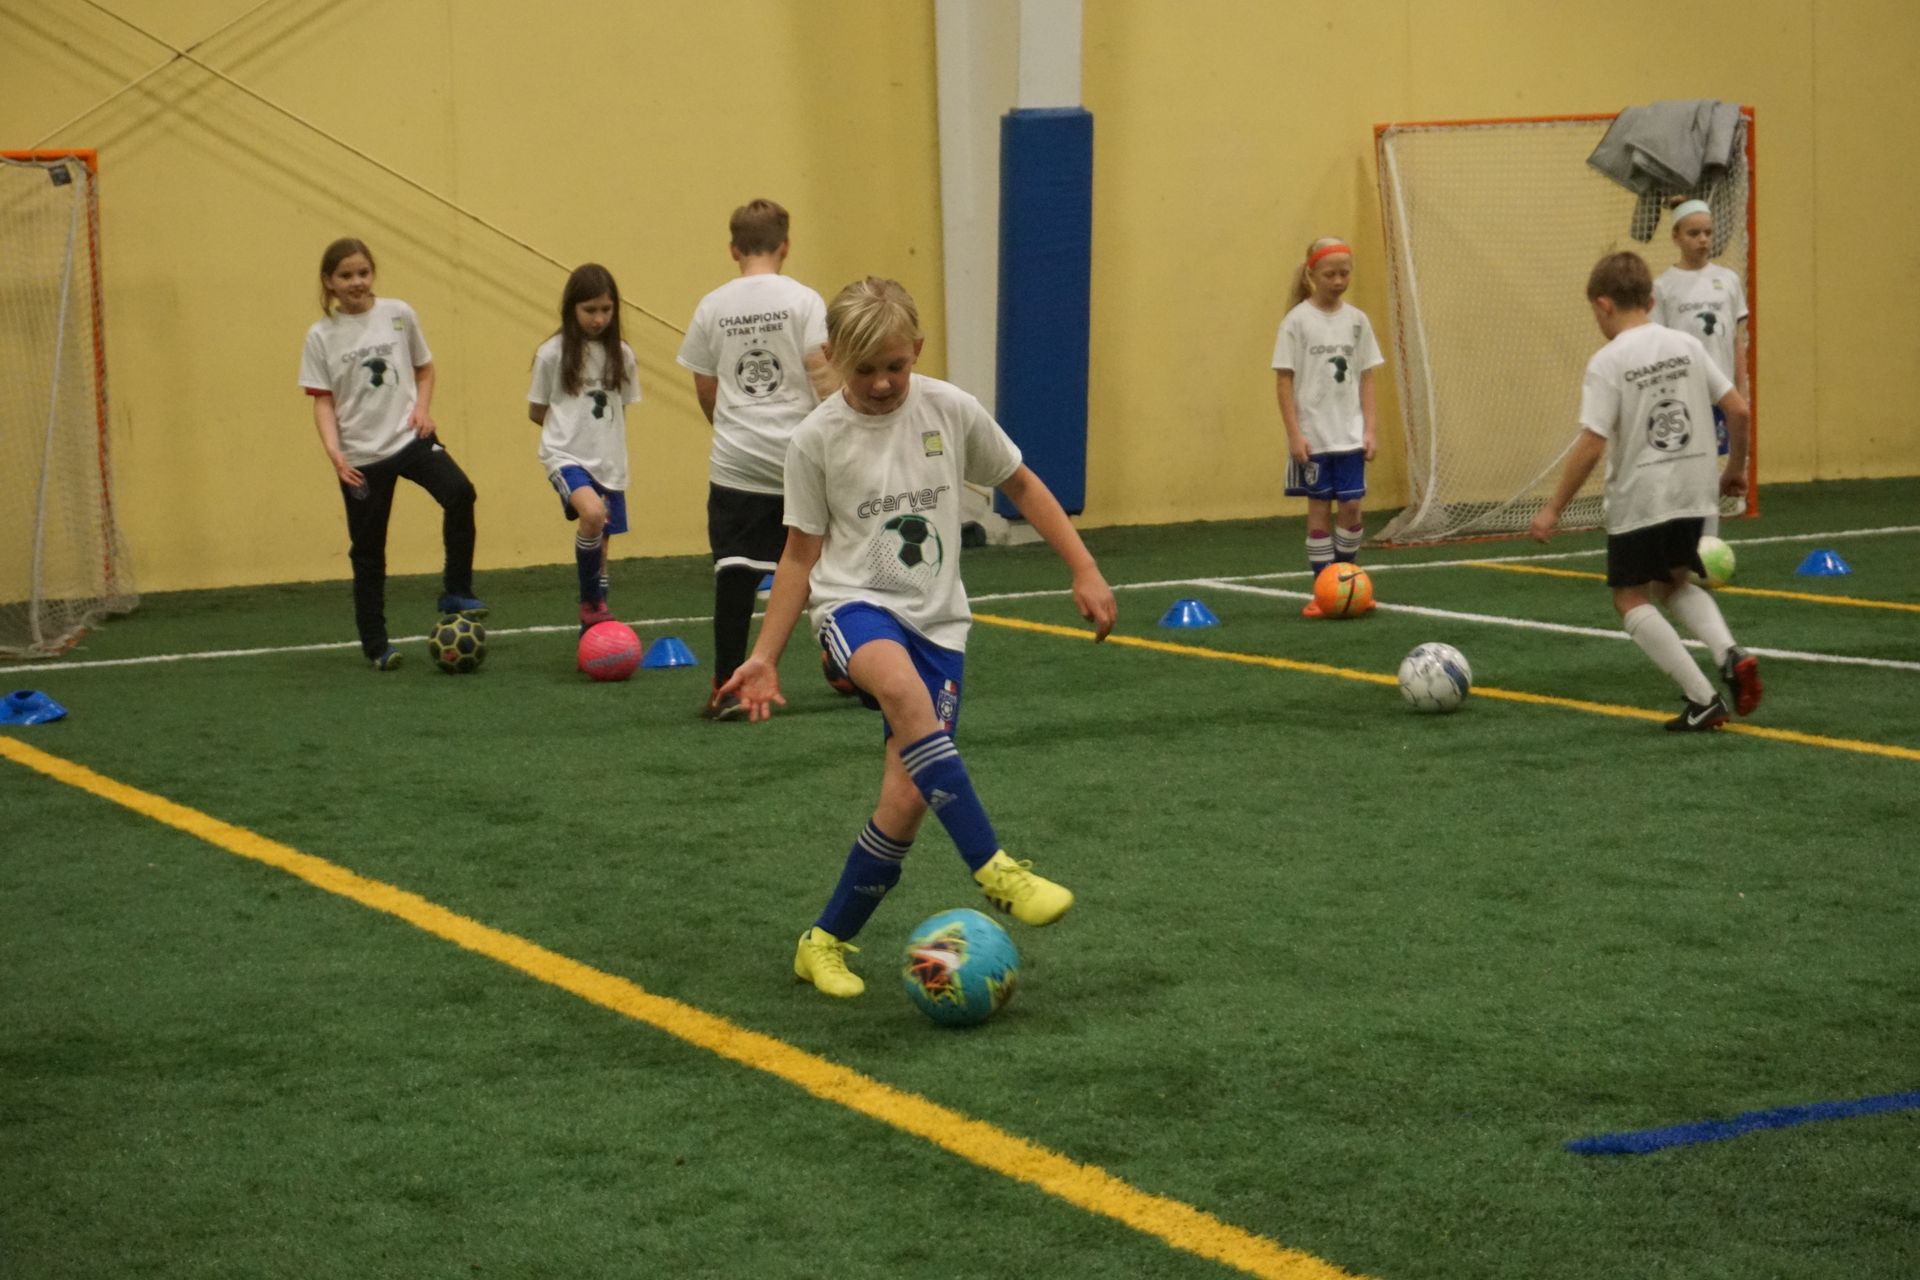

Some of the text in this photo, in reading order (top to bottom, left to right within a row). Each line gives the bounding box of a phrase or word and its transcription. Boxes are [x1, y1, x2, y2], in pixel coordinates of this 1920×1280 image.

[718, 310, 788, 328] CHAMPIONS
[726, 322, 784, 337] START HERE
[744, 360, 773, 383] 35
[1624, 355, 1691, 382] CHAMPIONS
[1655, 409, 1685, 438] 35
